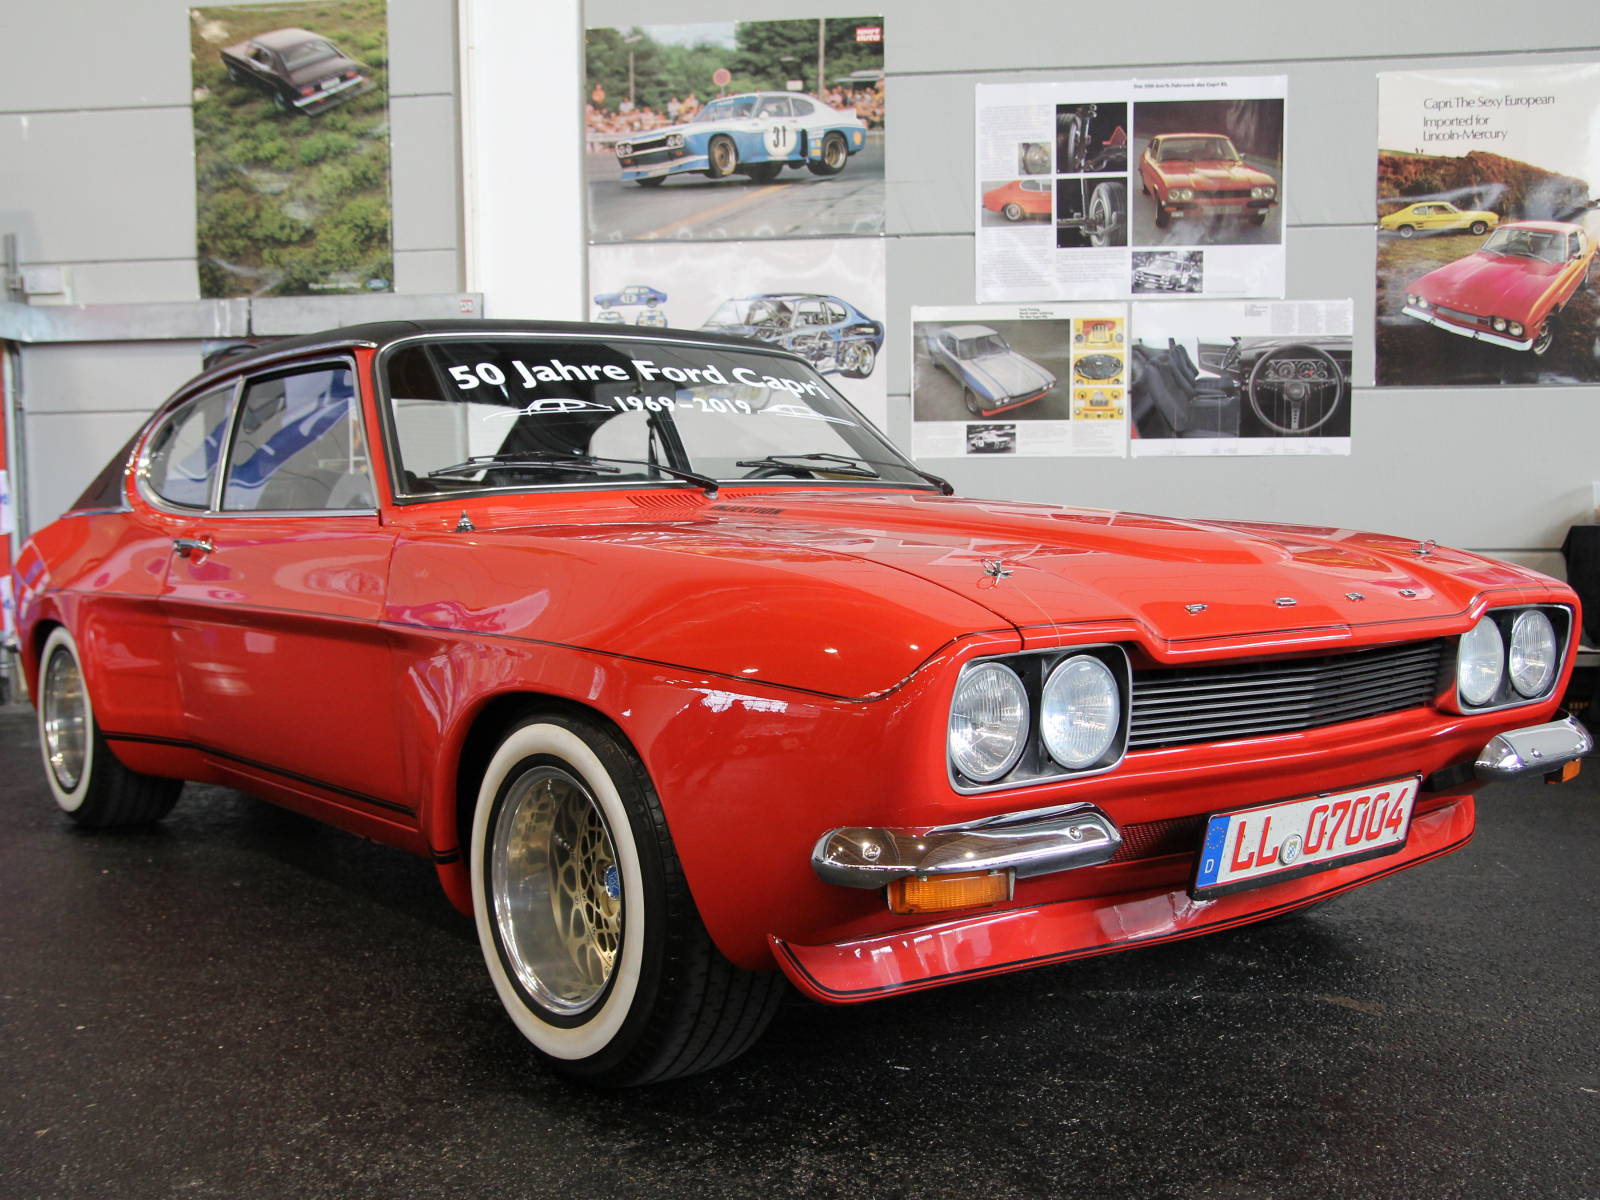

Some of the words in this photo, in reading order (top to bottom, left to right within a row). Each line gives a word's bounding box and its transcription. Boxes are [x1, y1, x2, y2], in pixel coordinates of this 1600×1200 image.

[1455, 97, 1475, 108] The
[1477, 96, 1503, 109] Sexy
[1505, 94, 1555, 108] European
[1423, 114, 1473, 129] Imported
[1475, 114, 1490, 126] for
[772, 125, 787, 148] 31
[1423, 129, 1508, 141] Lincoln-Mercury
[448, 362, 506, 390] 50
[511, 359, 630, 389] Jahre
[631, 360, 729, 385] Ford
[732, 367, 831, 400] Capri
[614, 396, 675, 412] 1969
[692, 397, 751, 415] 2019
[709, 504, 787, 515] INJECTION
[1230, 815, 1279, 872] LL
[1303, 787, 1409, 855] 07004
[1204, 858, 1214, 874] D
